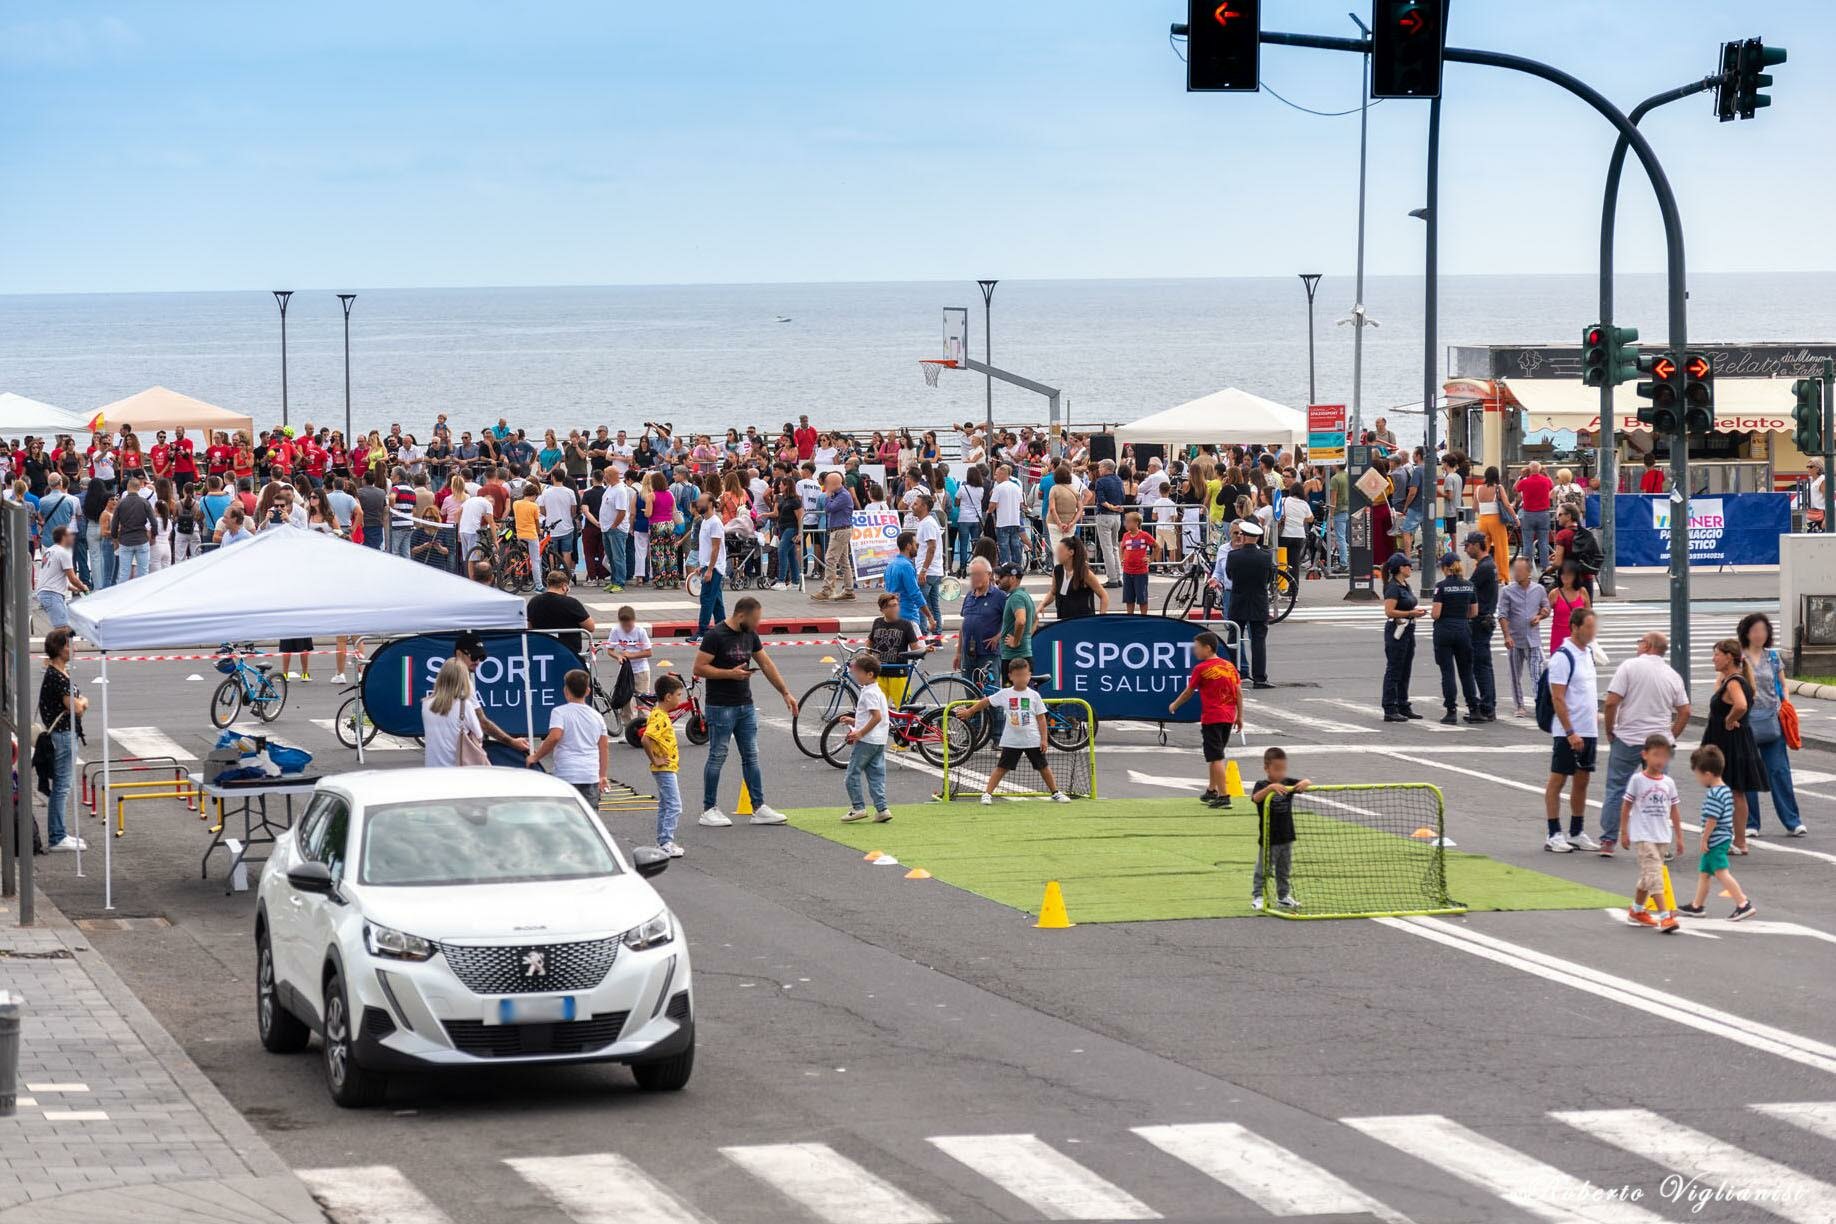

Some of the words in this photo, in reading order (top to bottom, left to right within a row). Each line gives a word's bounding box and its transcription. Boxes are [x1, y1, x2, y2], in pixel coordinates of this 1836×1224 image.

[850, 526, 882, 541] DAY
[1075, 641, 1195, 669] SPORT
[426, 655, 554, 684] SORT
[1075, 674, 1088, 692] E
